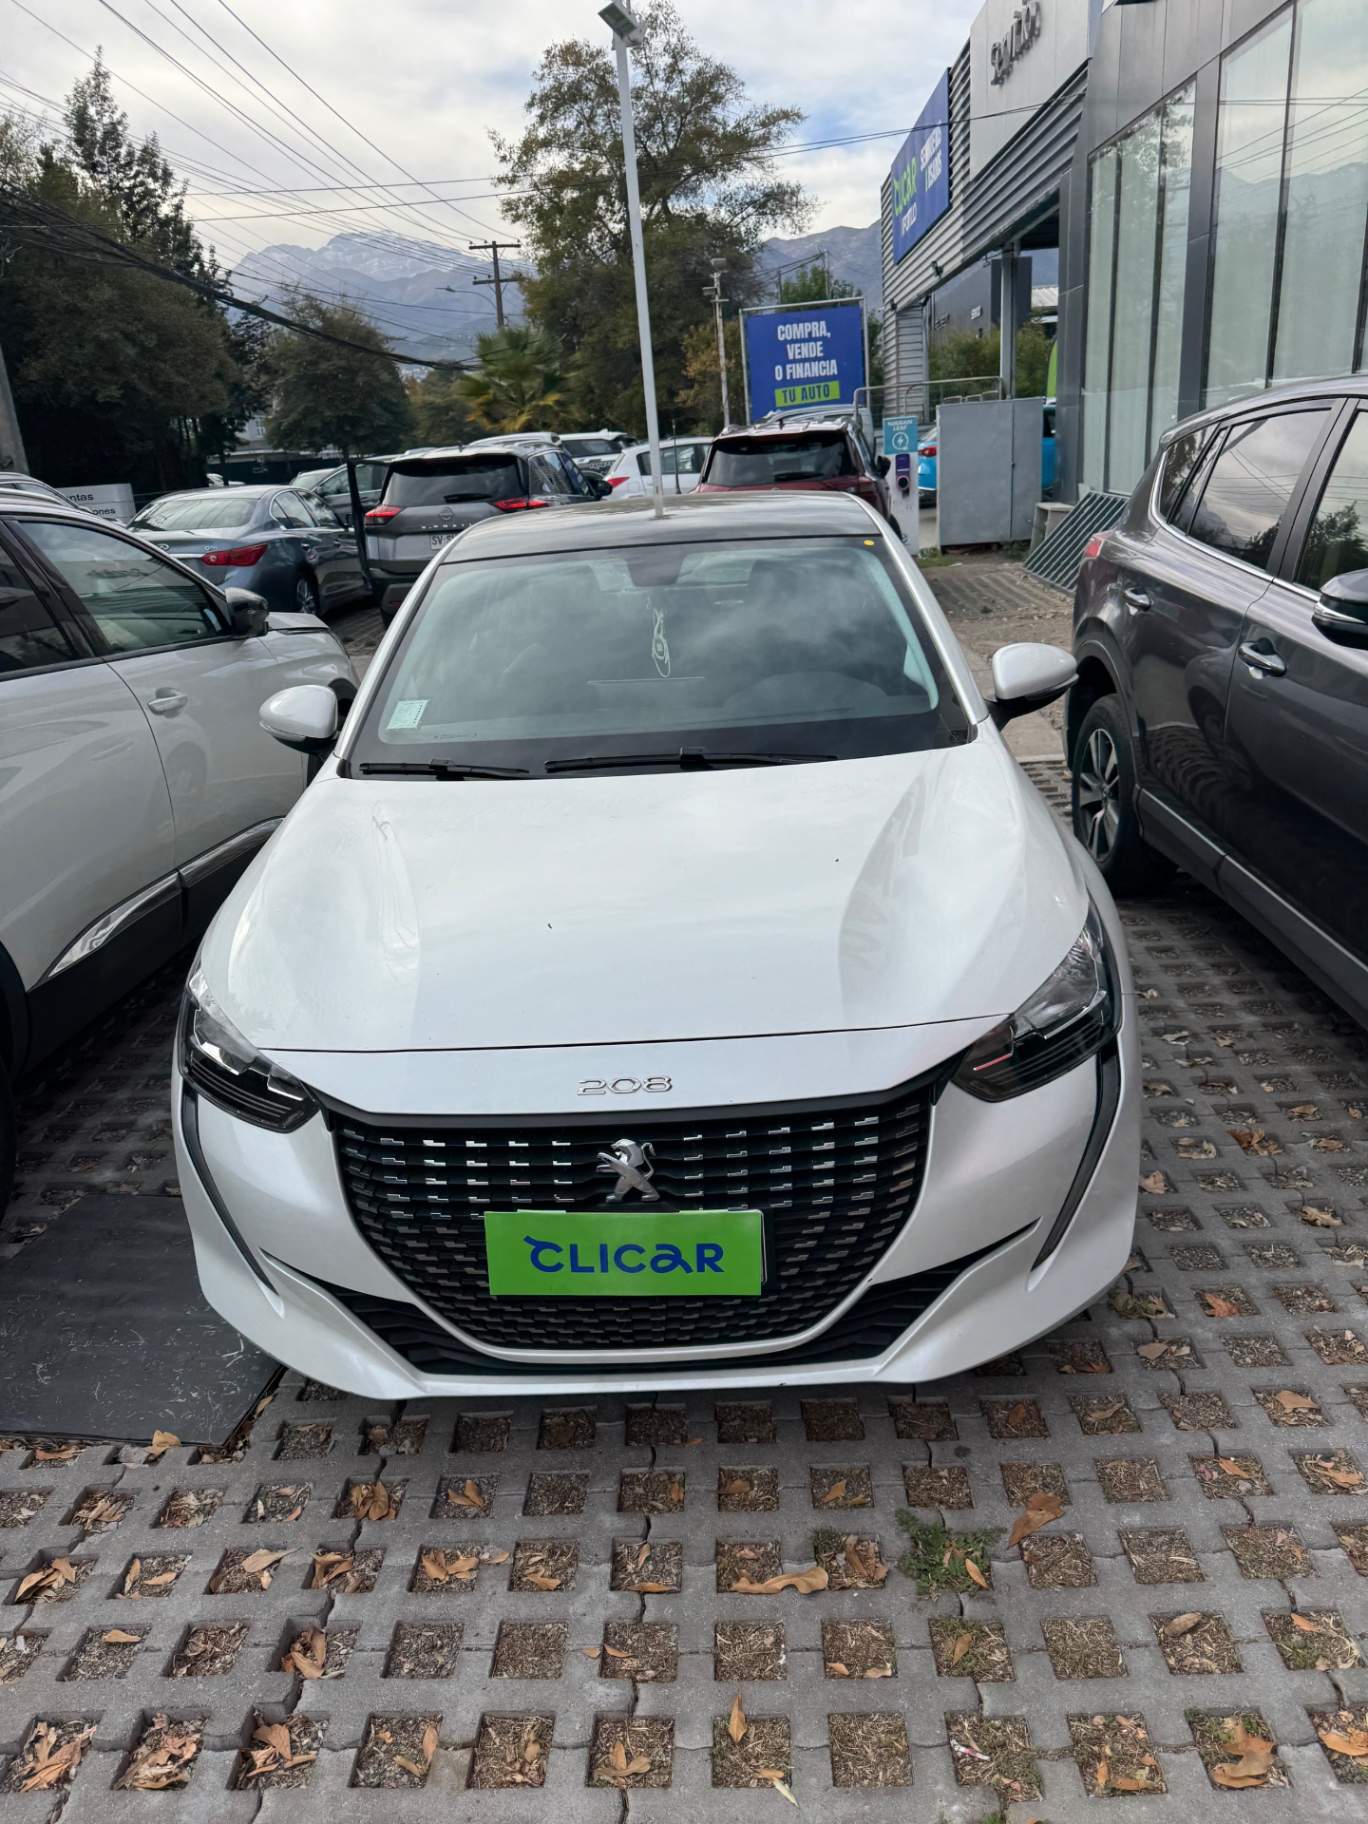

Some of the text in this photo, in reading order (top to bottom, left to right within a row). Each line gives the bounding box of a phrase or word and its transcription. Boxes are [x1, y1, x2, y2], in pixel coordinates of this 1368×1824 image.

[777, 320, 831, 341] COMPRA,
[787, 341, 824, 360] VENDE
[774, 359, 838, 381] O FINANCIA
[782, 383, 830, 403] TU AUTO
[66, 493, 94, 502] ntas
[577, 1076, 673, 1096] 208
